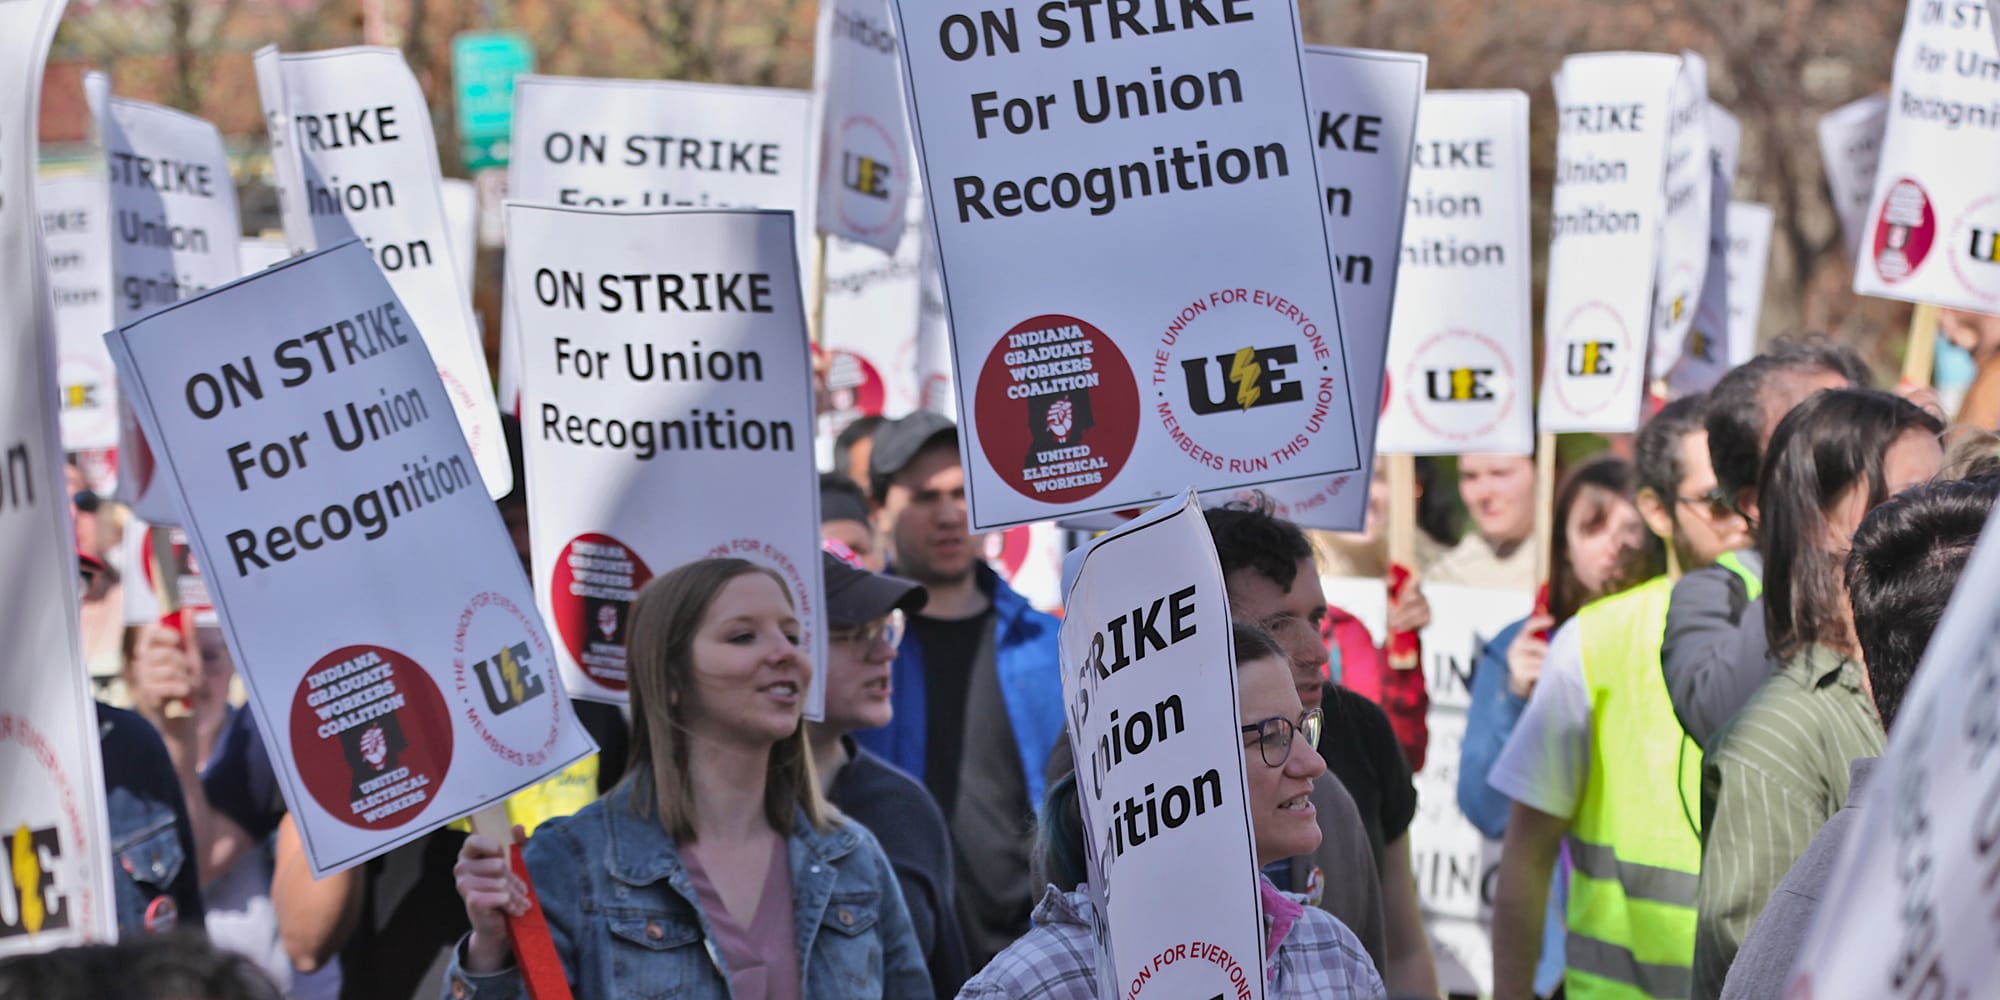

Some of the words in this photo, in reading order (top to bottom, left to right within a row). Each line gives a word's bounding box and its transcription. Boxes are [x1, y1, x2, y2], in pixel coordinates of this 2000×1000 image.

[939, 7, 1020, 62] ON
[971, 91, 1056, 139] For
[1073, 66, 1243, 123] Union
[1902, 89, 2000, 130] Recogni
[544, 132, 606, 164] ON
[624, 136, 780, 175] STRIKE
[953, 140, 1290, 223] Recognition
[120, 210, 208, 253] Union
[534, 267, 586, 311] ON
[598, 272, 774, 313] STRIKE
[1209, 288, 1248, 308] FOR
[1008, 325, 1084, 348] INDIANA
[1161, 299, 1208, 346] UNION
[1252, 289, 1330, 361] EVERYONE
[185, 356, 264, 420] ON
[273, 301, 409, 388] STRIKE
[555, 337, 610, 380] For
[624, 340, 764, 382] Union
[1004, 340, 1094, 366] GRADUATE
[1009, 357, 1093, 382] WORKERS
[1153, 349, 1170, 385] THE
[1567, 341, 1614, 376] UE
[1007, 373, 1100, 399] COALITION
[1180, 344, 1304, 416] UE
[1425, 367, 1494, 402] UE
[226, 431, 309, 492] For
[322, 387, 430, 452] Union
[541, 402, 796, 461] Recognition
[1157, 402, 1225, 471] MEMBERS
[1229, 457, 1269, 474] RUN
[1271, 434, 1310, 465] THIS
[1305, 376, 1334, 434] UNION
[1022, 457, 1108, 481] ELECTRICAL
[1036, 445, 1091, 464] UNITED
[1033, 471, 1103, 493] WORKERS
[226, 454, 472, 578] Recognition
[306, 651, 382, 690] INDIANA
[1078, 584, 1197, 726] STRIKE
[306, 663, 394, 707] GRADUATE
[315, 680, 396, 721] WORKERS
[473, 641, 545, 716] UE
[317, 693, 406, 739] COALITION
[1092, 694, 1185, 801] Union
[351, 774, 430, 814] ELECTRICAL
[359, 766, 410, 794] UNITED
[362, 789, 427, 823] WORKERS
[1101, 768, 1223, 907] gnition
[1153, 944, 1186, 972] FOR
[1190, 942, 1252, 1000] EVERYONE
